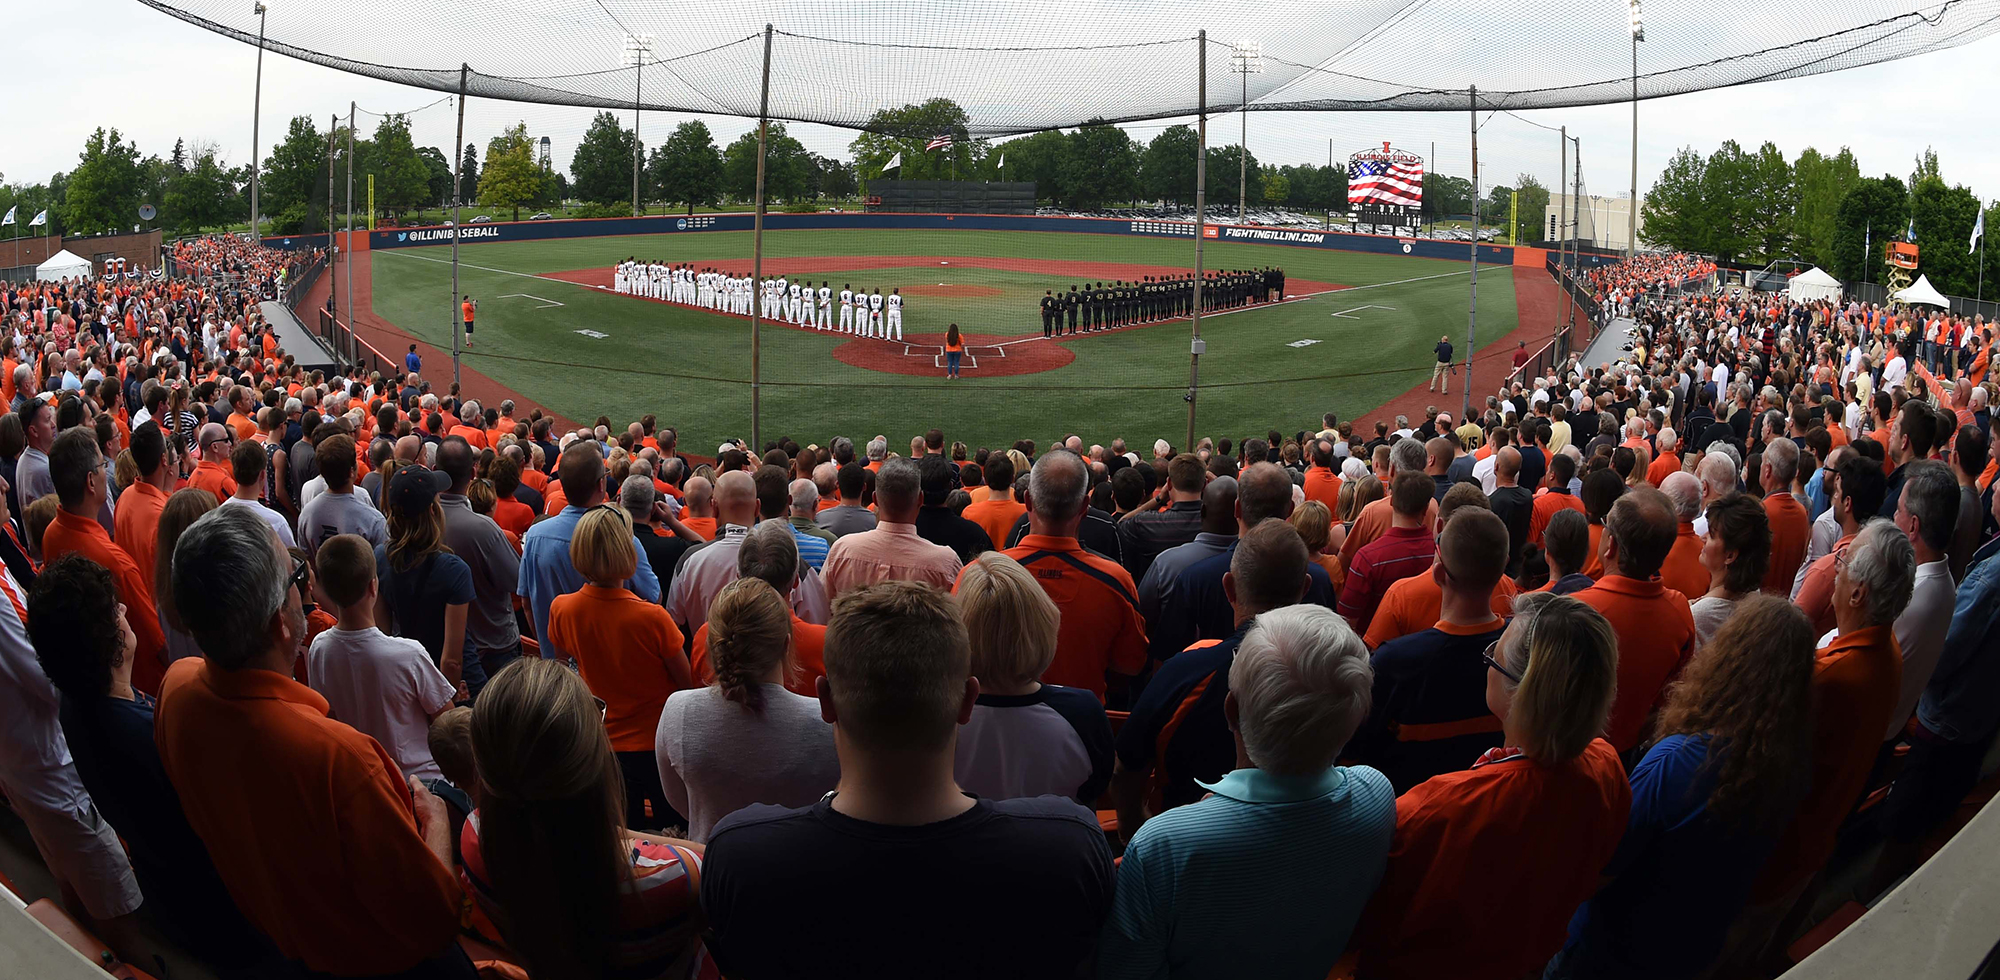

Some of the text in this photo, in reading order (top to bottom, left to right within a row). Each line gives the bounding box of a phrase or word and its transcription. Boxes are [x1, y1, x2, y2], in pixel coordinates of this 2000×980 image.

[1383, 142, 1390, 153] I
[1225, 228, 1325, 243] FIGHTINGILLINI.COM
[1468, 436, 1478, 450] 15
[1038, 568, 1063, 579] ILLINOIS
